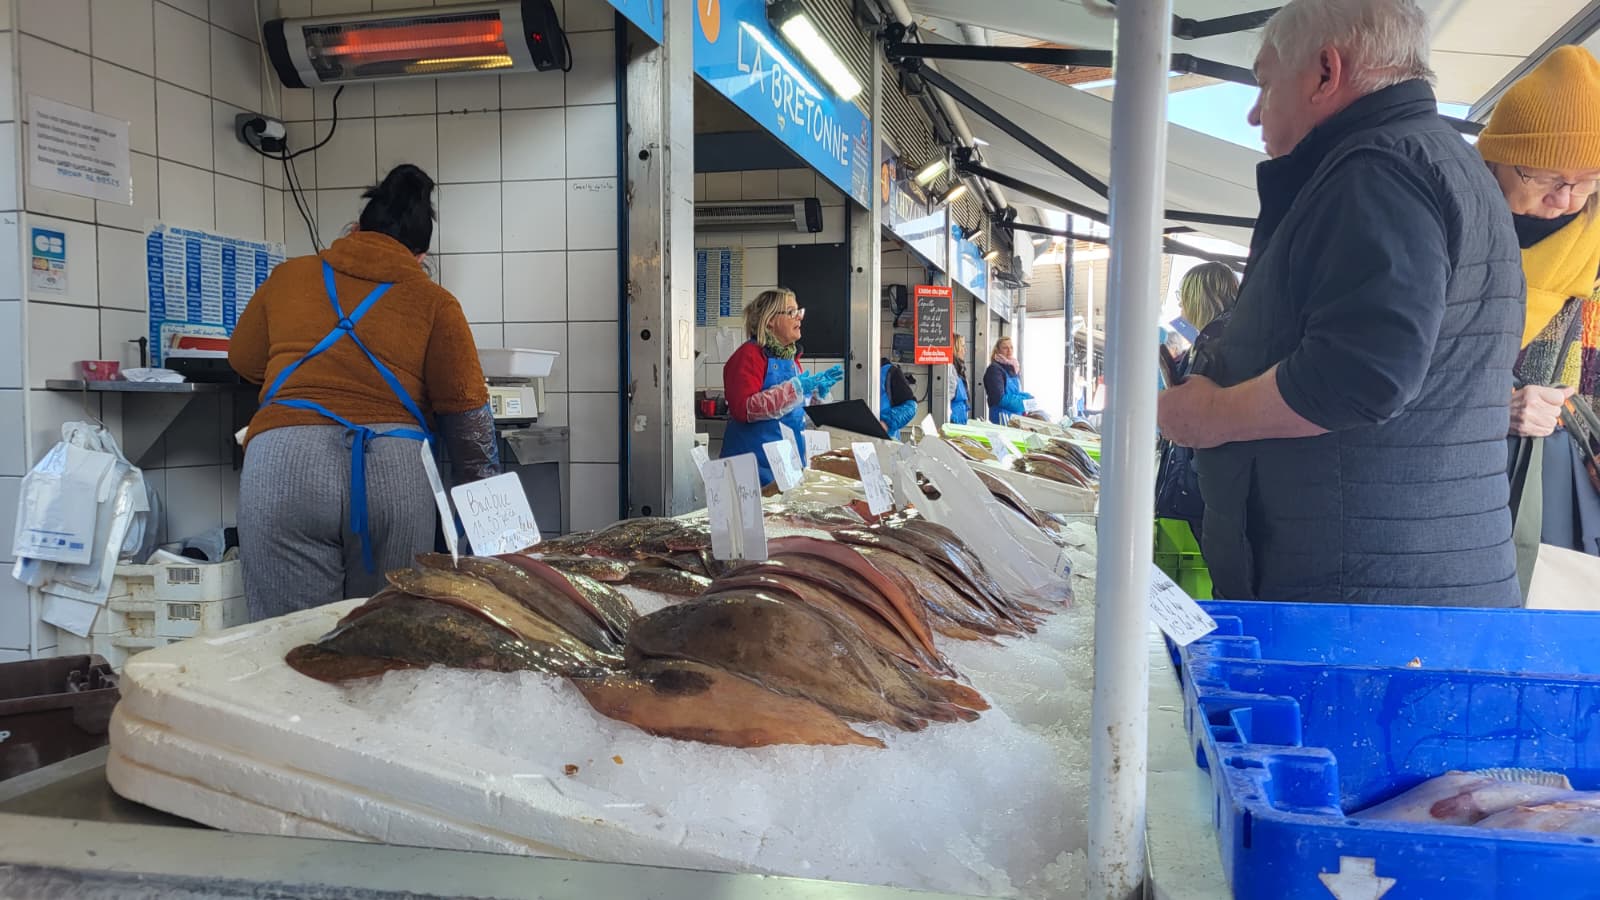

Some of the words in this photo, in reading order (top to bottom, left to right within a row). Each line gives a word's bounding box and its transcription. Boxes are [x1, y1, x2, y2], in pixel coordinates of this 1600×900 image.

[737, 25, 765, 94] LA
[771, 63, 849, 166] BRETONNE
[35, 235, 63, 253] CB
